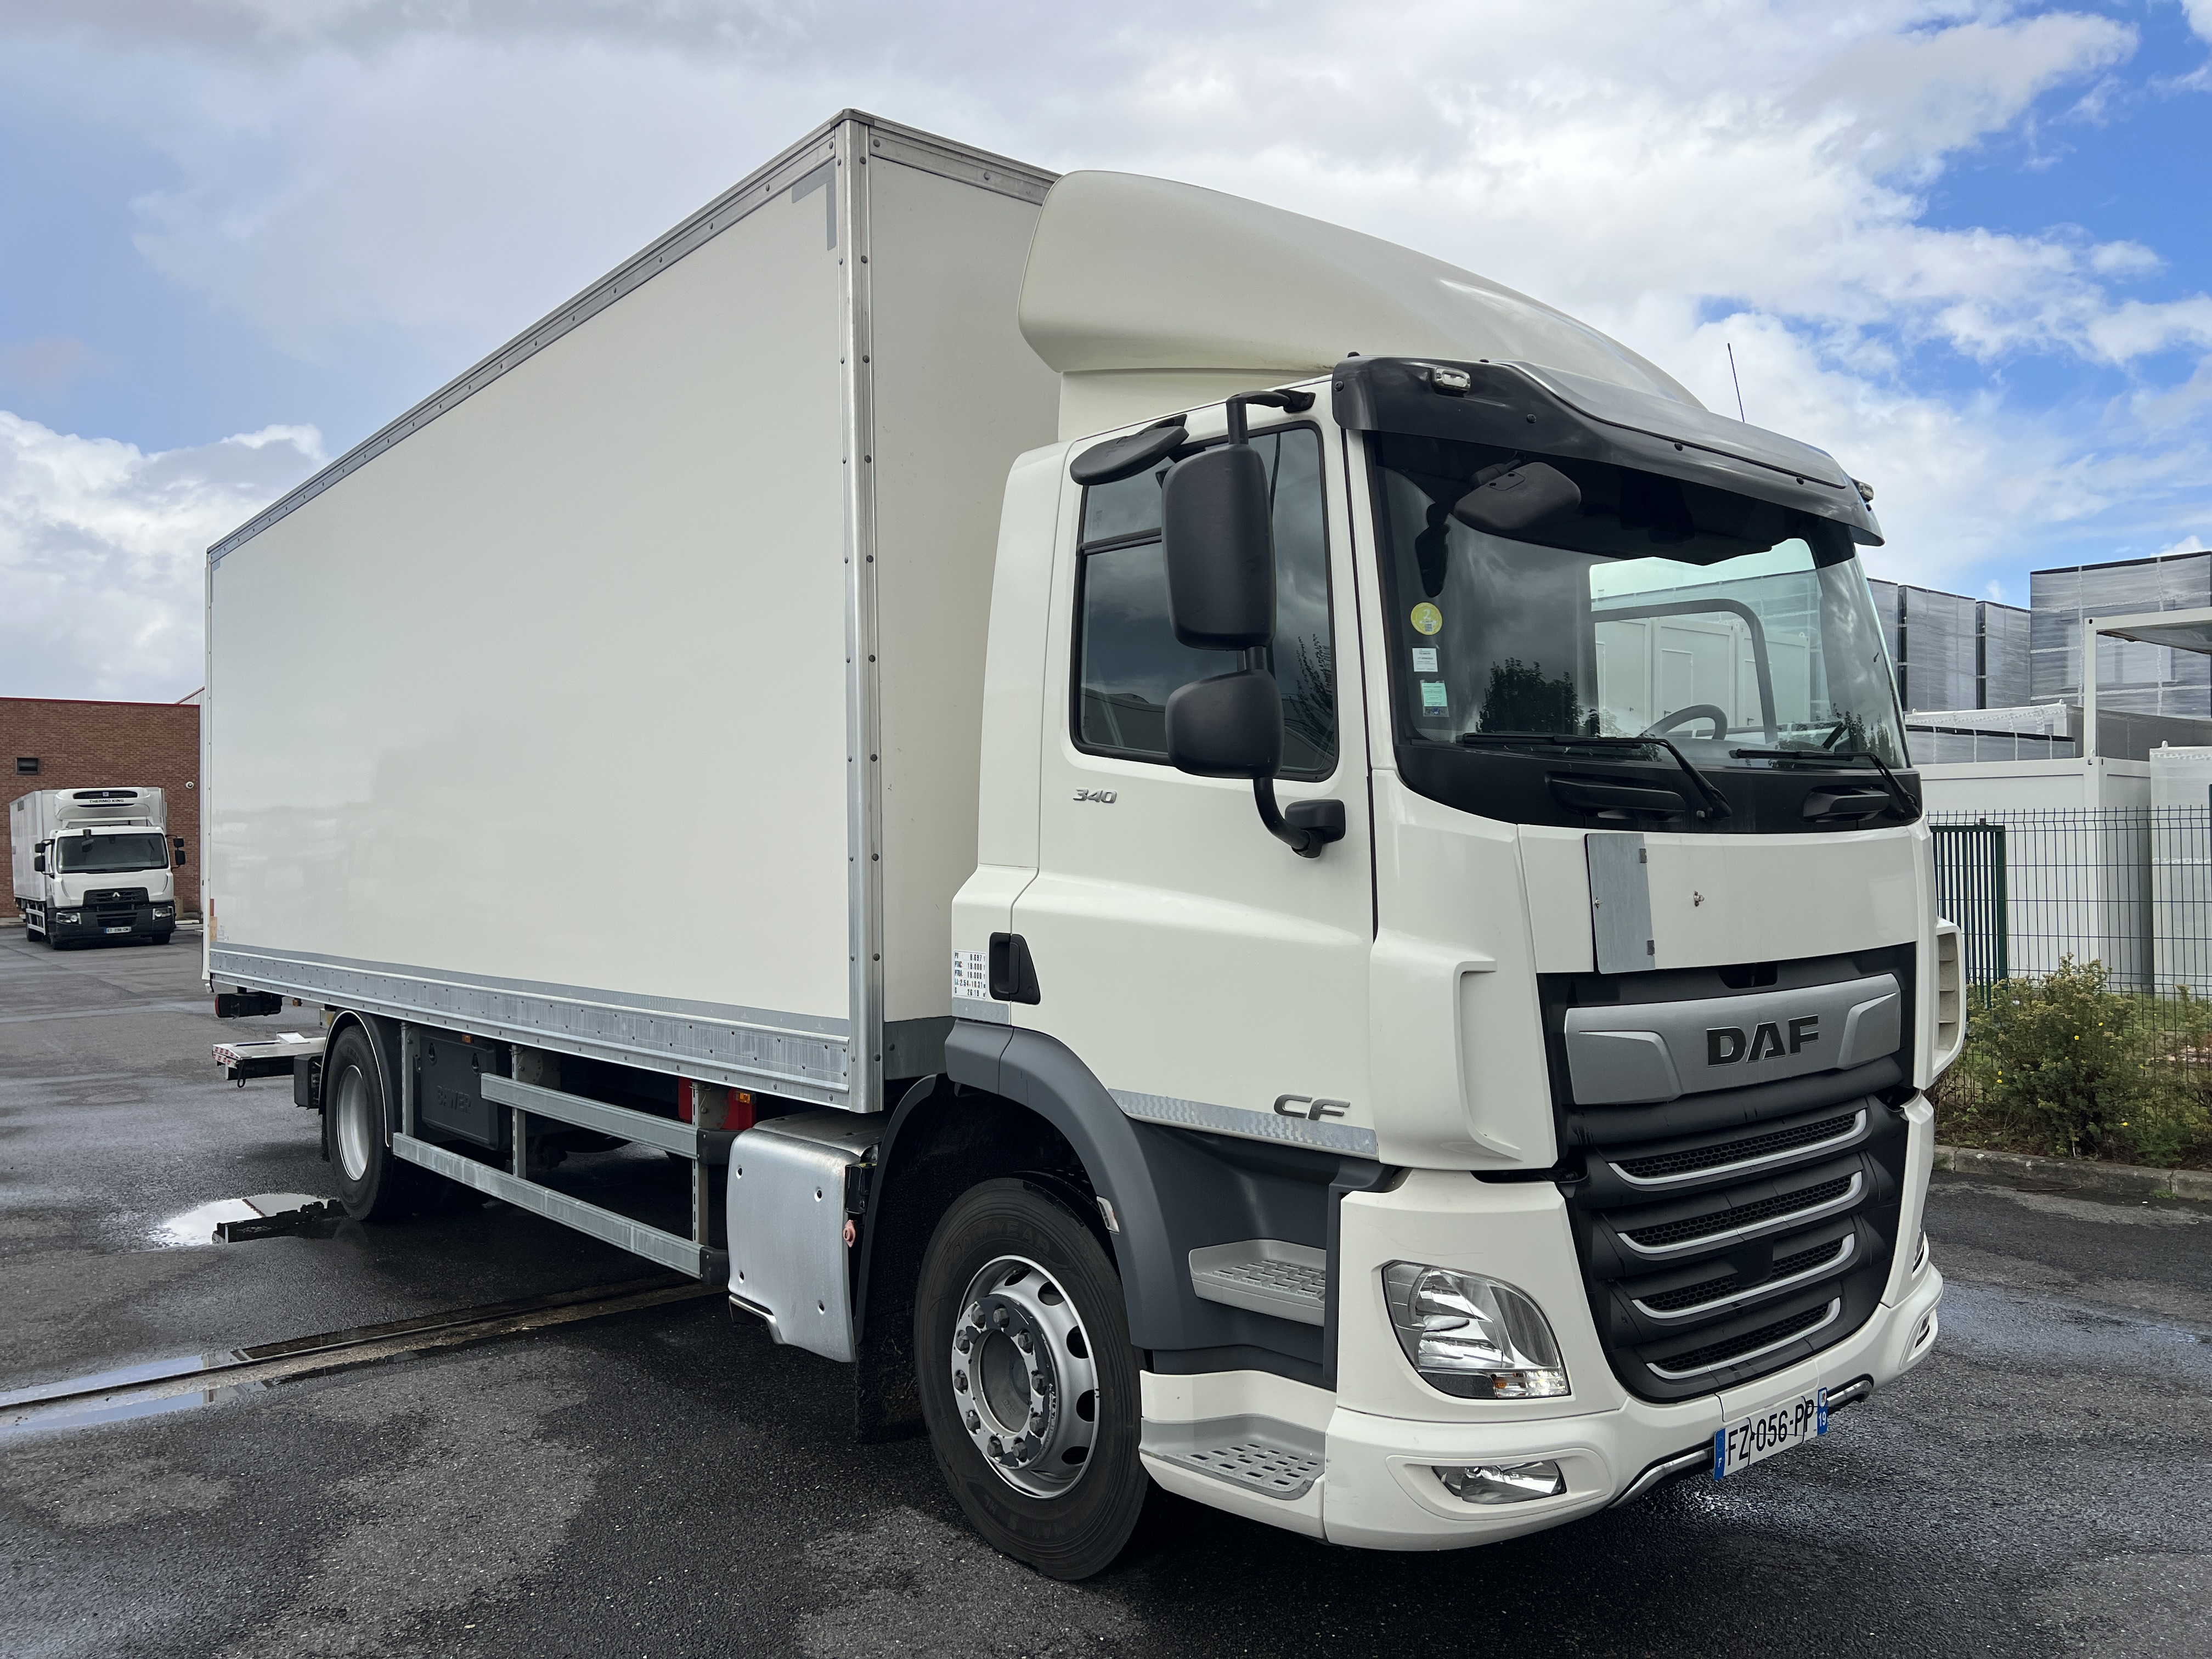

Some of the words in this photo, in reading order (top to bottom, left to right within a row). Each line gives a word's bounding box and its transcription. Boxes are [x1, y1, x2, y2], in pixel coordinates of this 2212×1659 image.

[1423, 608, 1431, 620] 2
[1073, 788, 1117, 803] 340
[1706, 1014, 1819, 1068] DAF
[1273, 1093, 1351, 1121] CF
[944, 1219, 1051, 1275] GOODYEAR
[1718, 1457, 1722, 1468] F
[1818, 1411, 1827, 1427] 19
